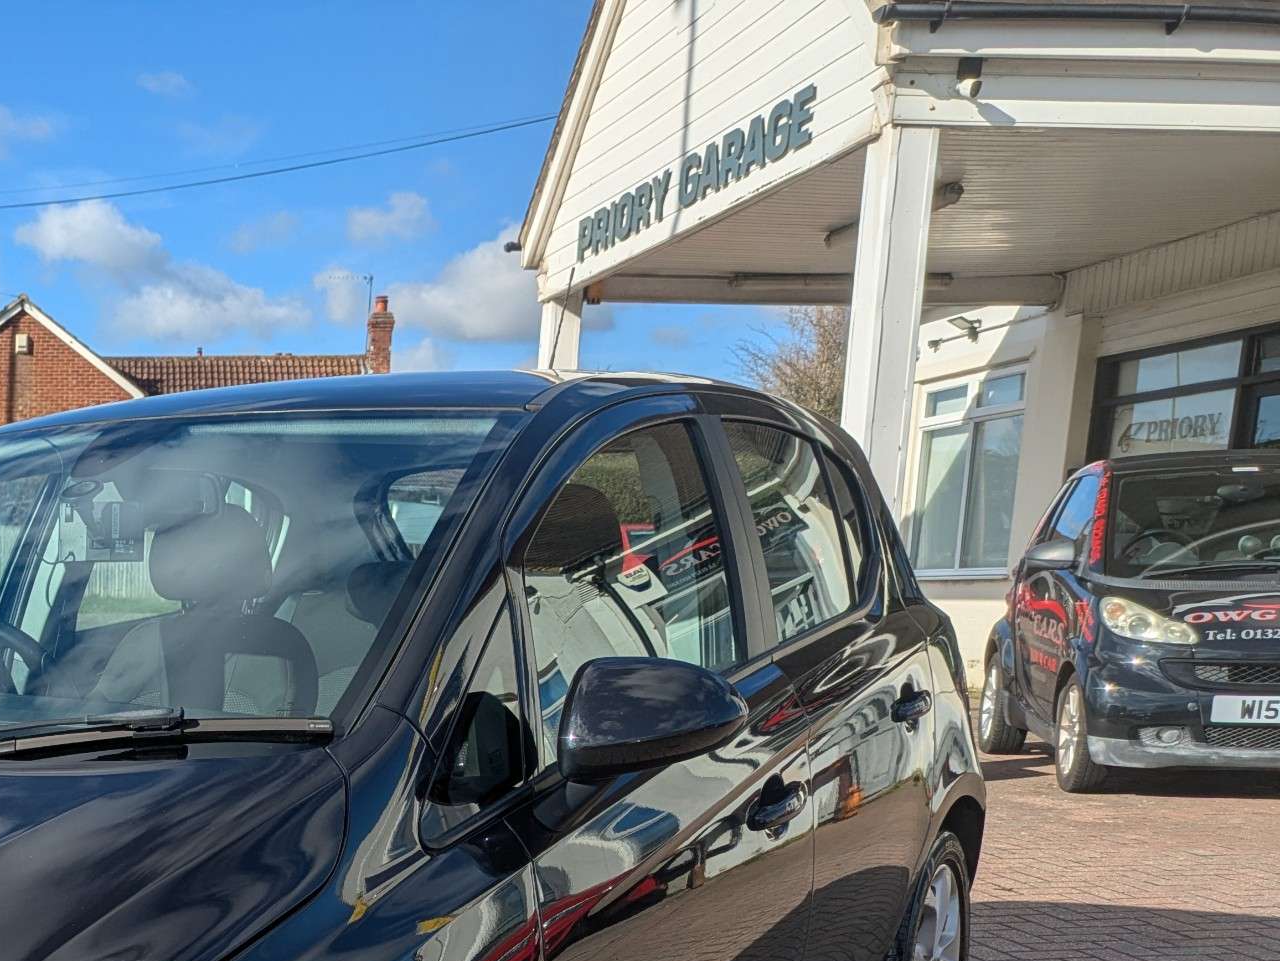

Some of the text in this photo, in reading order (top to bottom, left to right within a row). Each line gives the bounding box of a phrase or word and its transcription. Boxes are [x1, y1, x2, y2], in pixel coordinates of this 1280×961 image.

[577, 82, 817, 263] PRIORY GARAGE
[1145, 412, 1222, 443] PRIORY
[1183, 609, 1279, 624] OWG
[1205, 629, 1236, 640] Tel:
